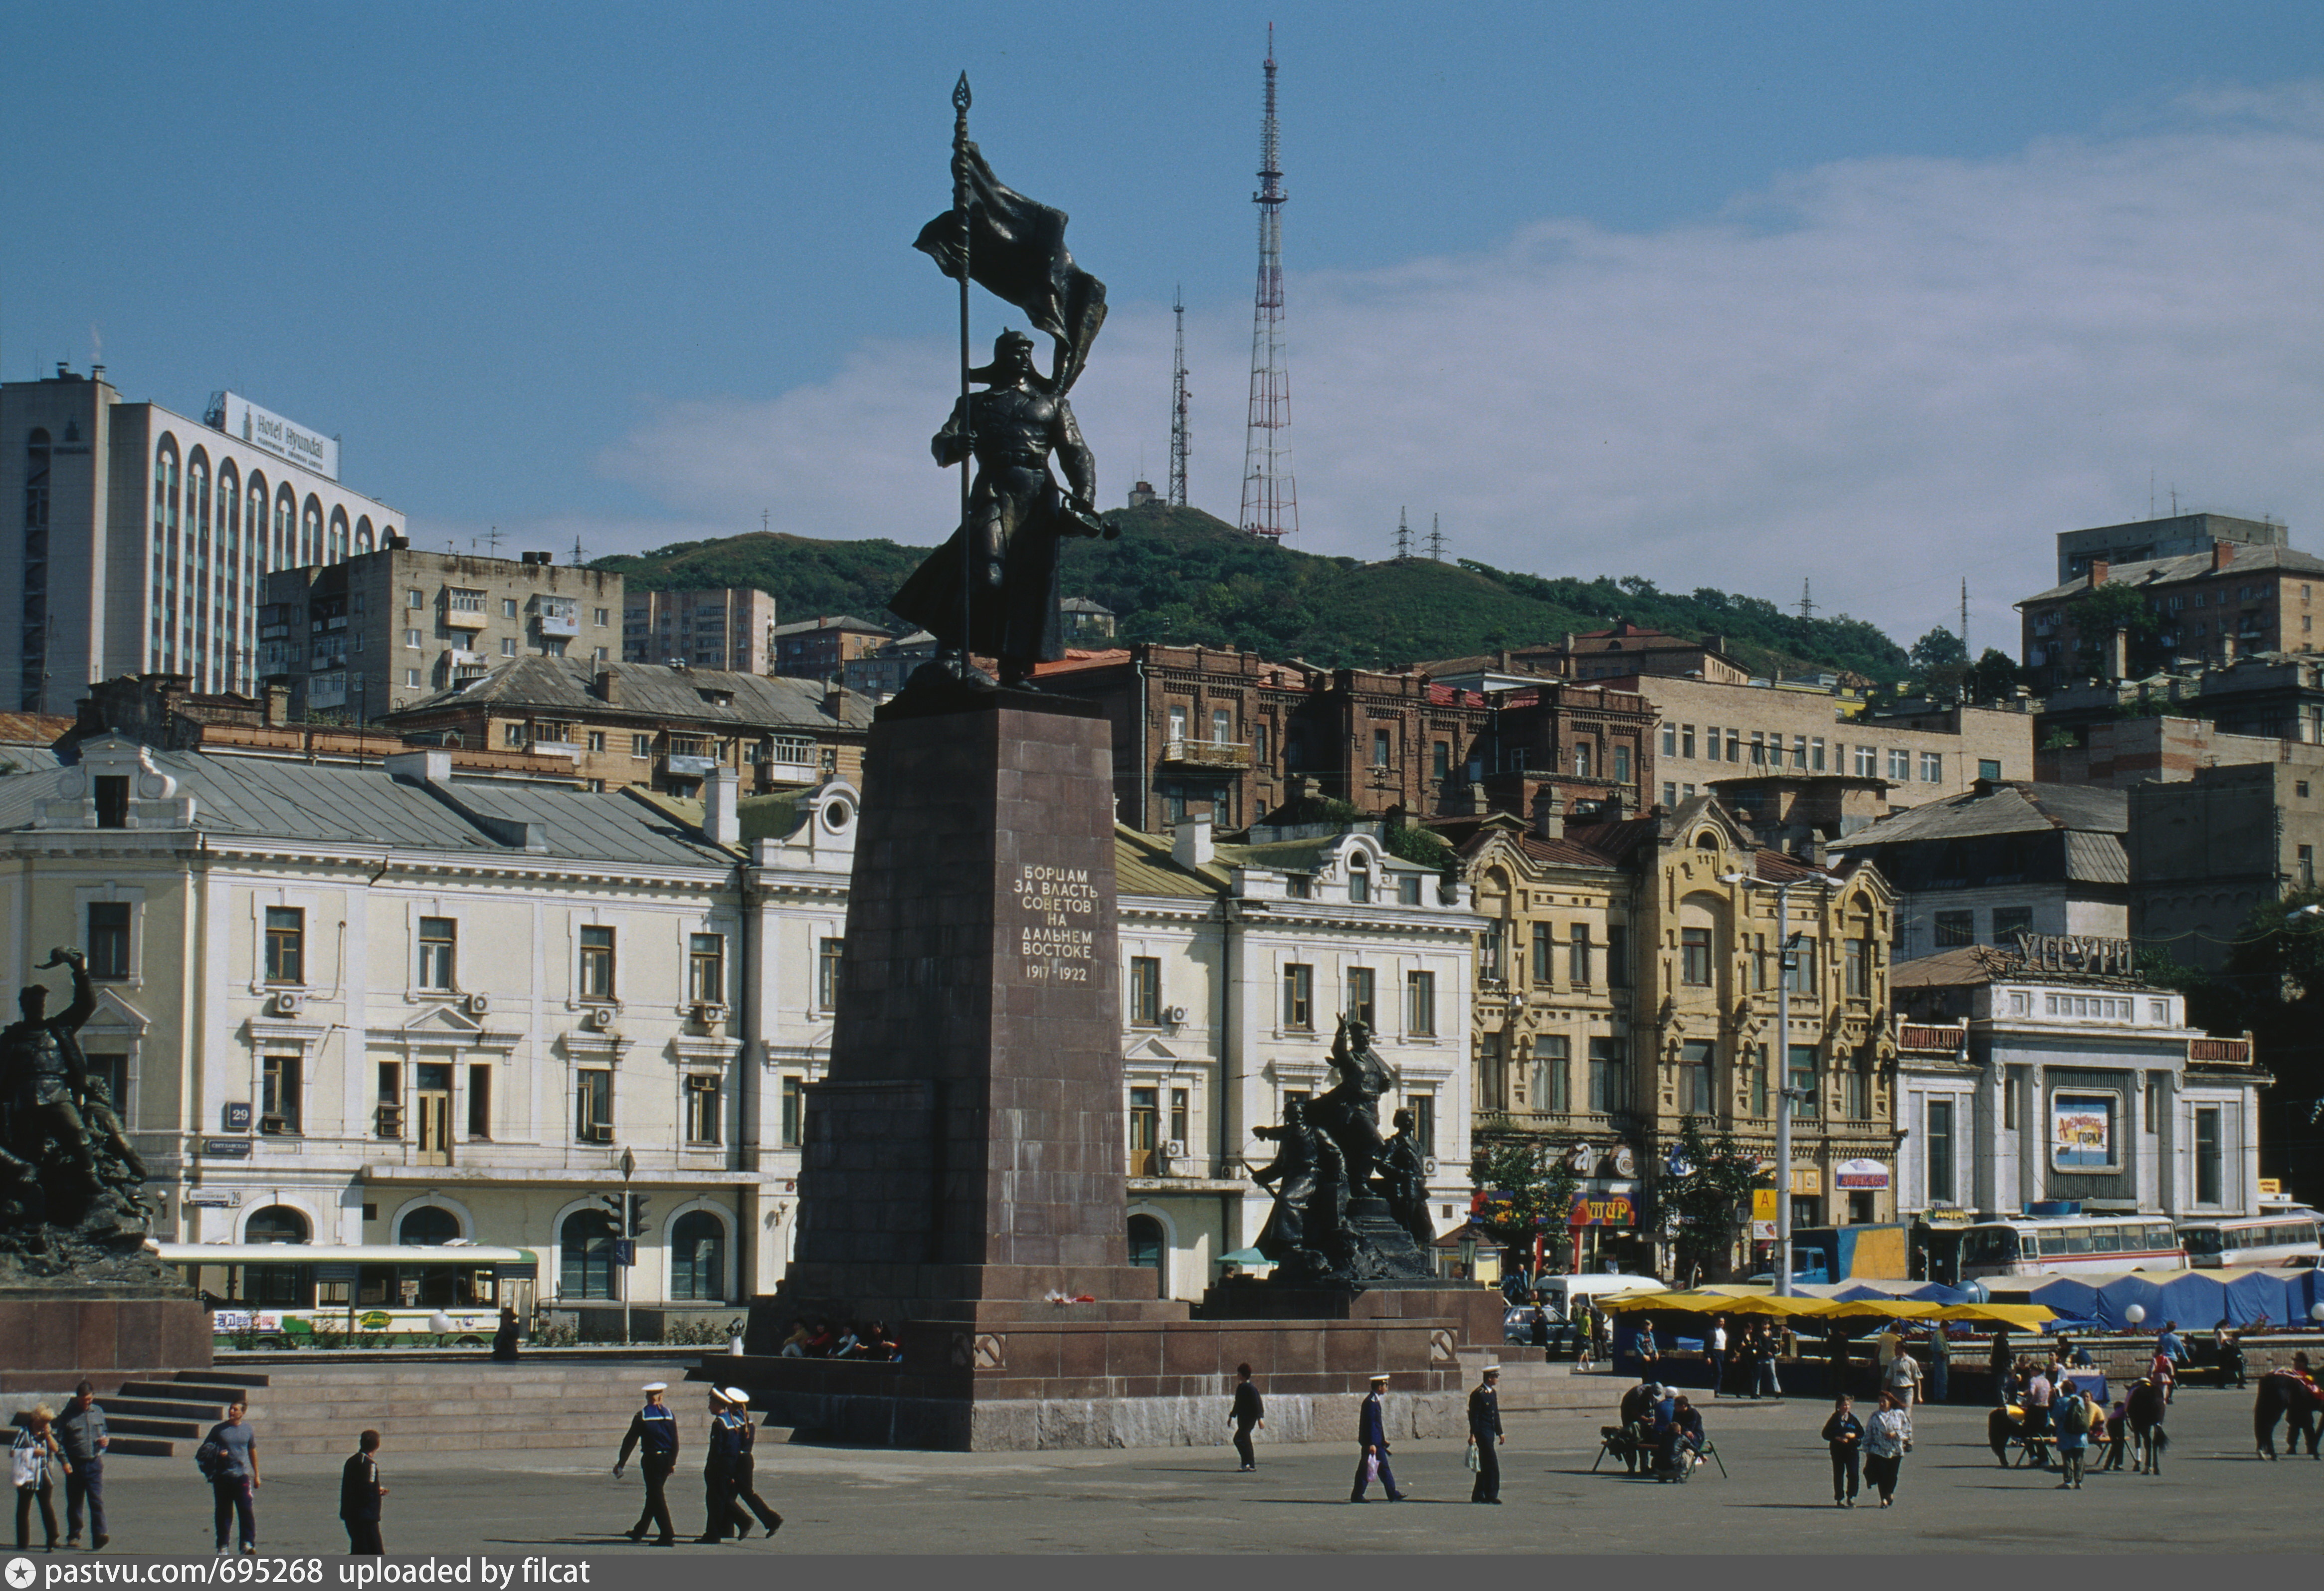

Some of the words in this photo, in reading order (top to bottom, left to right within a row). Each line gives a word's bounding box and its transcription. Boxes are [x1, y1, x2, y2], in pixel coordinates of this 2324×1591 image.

[258, 415, 282, 441] Hotel
[286, 427, 323, 459] Hyundai
[1024, 865, 1088, 884] БОРЦАМ
[1013, 879, 1034, 894] ЗА
[1042, 882, 1098, 898] ВЛАСТЬ
[1022, 895, 1091, 913] СОВЕТОВ
[1047, 912, 1067, 926] НА
[1022, 926, 1093, 944] ДАЛЬНЕМ
[1022, 941, 1092, 959] ВОСТОКЕ
[1900, 1028, 1963, 1049] КИНОТЕАТР
[2191, 1041, 2248, 1061] КИНОТЕАТР
[232, 1109, 248, 1120] 29
[2077, 1132, 2104, 1143] ГОРКИ
[1841, 1174, 1887, 1186] АВИАКАССА
[231, 1191, 241, 1205] 29
[1760, 1192, 1770, 1207] А
